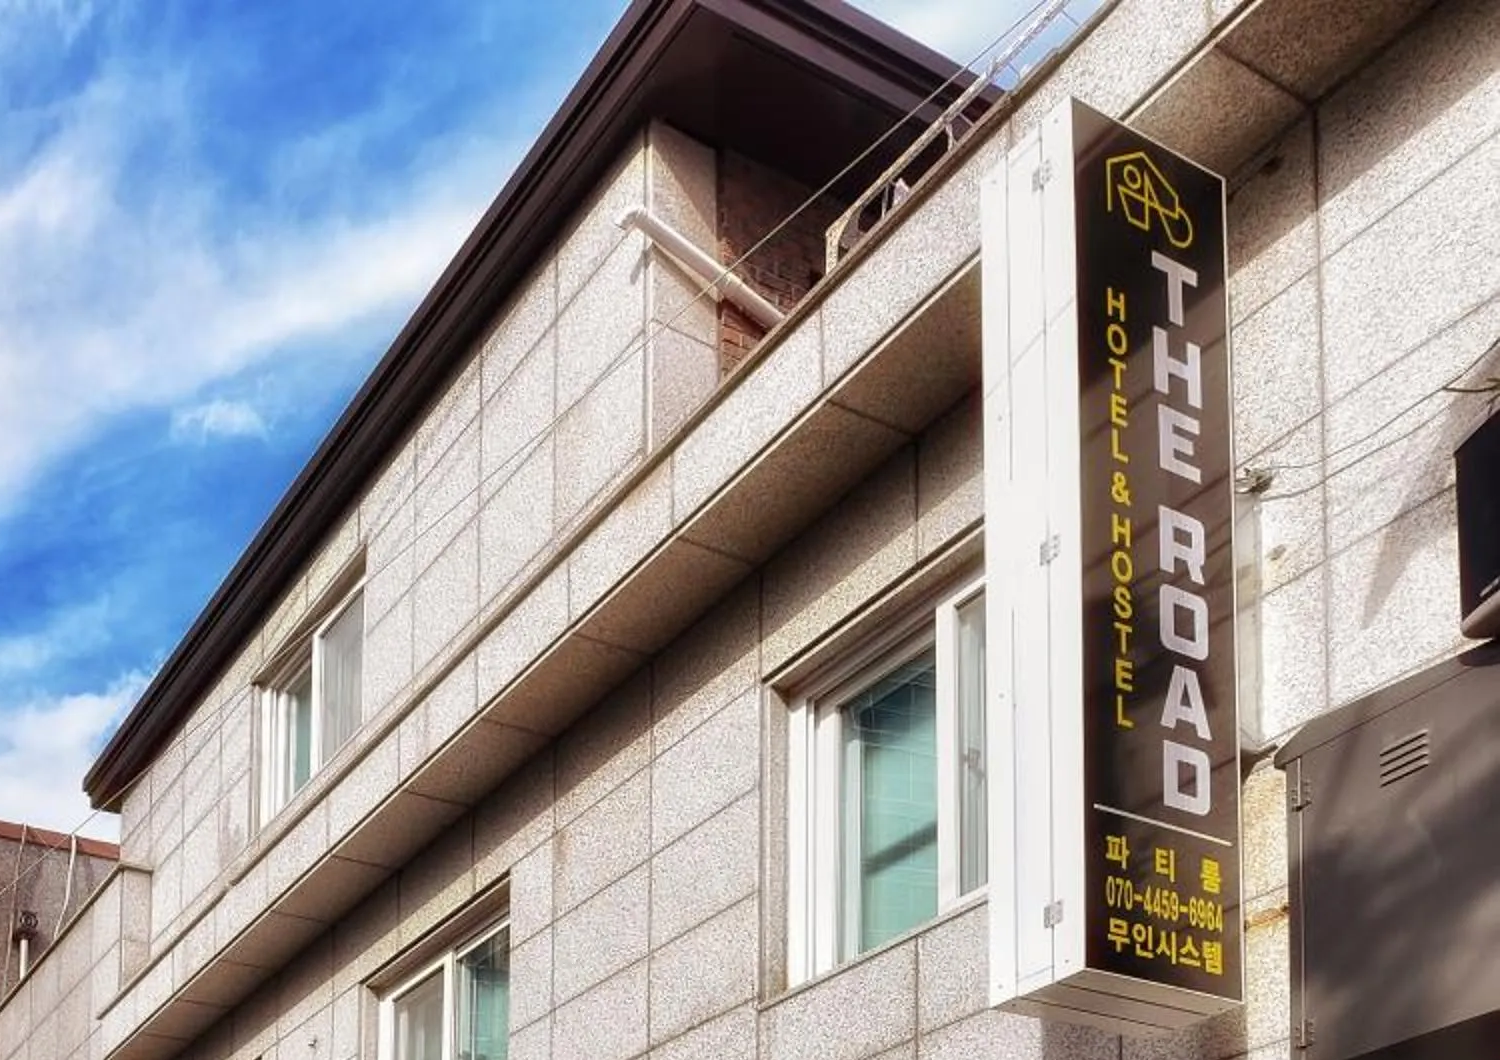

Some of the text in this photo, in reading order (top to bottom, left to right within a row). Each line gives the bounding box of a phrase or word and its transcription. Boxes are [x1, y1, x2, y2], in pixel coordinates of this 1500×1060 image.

[1106, 286, 1135, 729] HOTEL & HOSTEL
[1150, 249, 1213, 817] THE ROAD
[1107, 916, 1223, 976] 무인시스템
